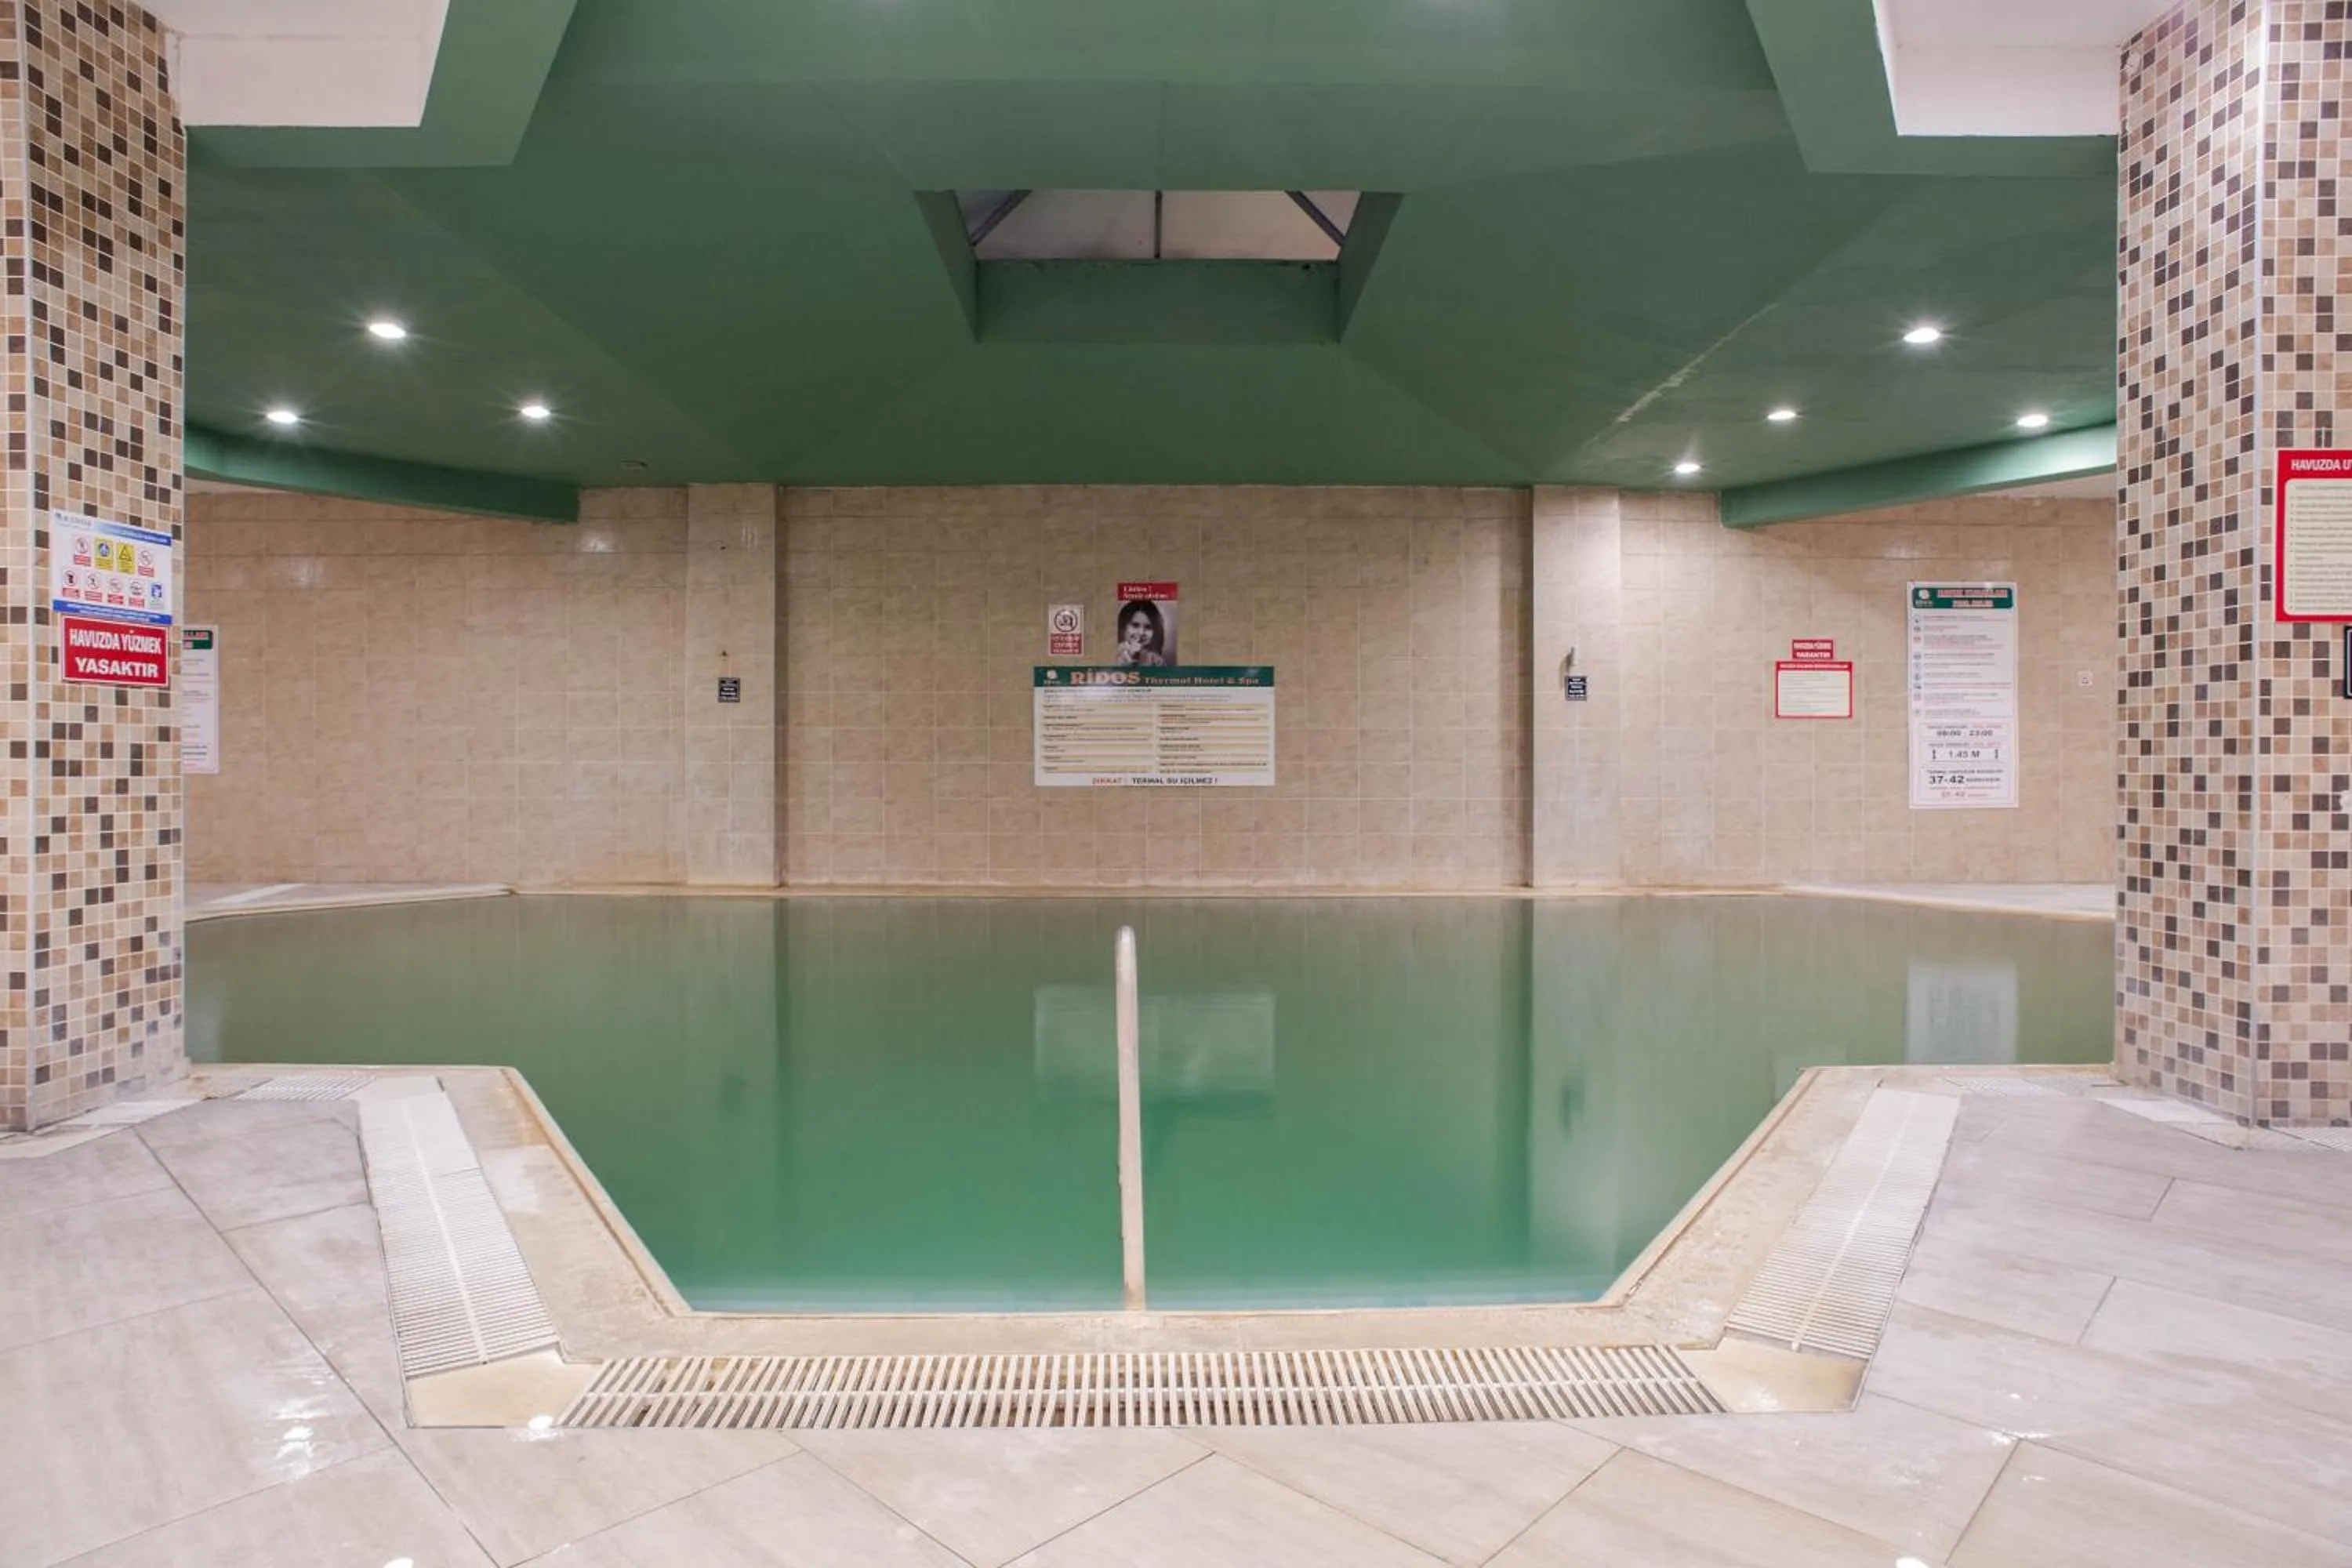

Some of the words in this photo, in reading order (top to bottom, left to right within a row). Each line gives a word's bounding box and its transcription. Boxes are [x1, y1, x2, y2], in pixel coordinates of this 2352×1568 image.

[2291, 459, 2341, 470] HAVUZDA
[70, 628, 120, 650] HAVUZDA
[121, 630, 162, 655] YÜZMEK
[75, 657, 158, 677] YASAKTIR
[1070, 668, 1141, 684] RİDOS
[1238, 677, 1258, 685] Spa
